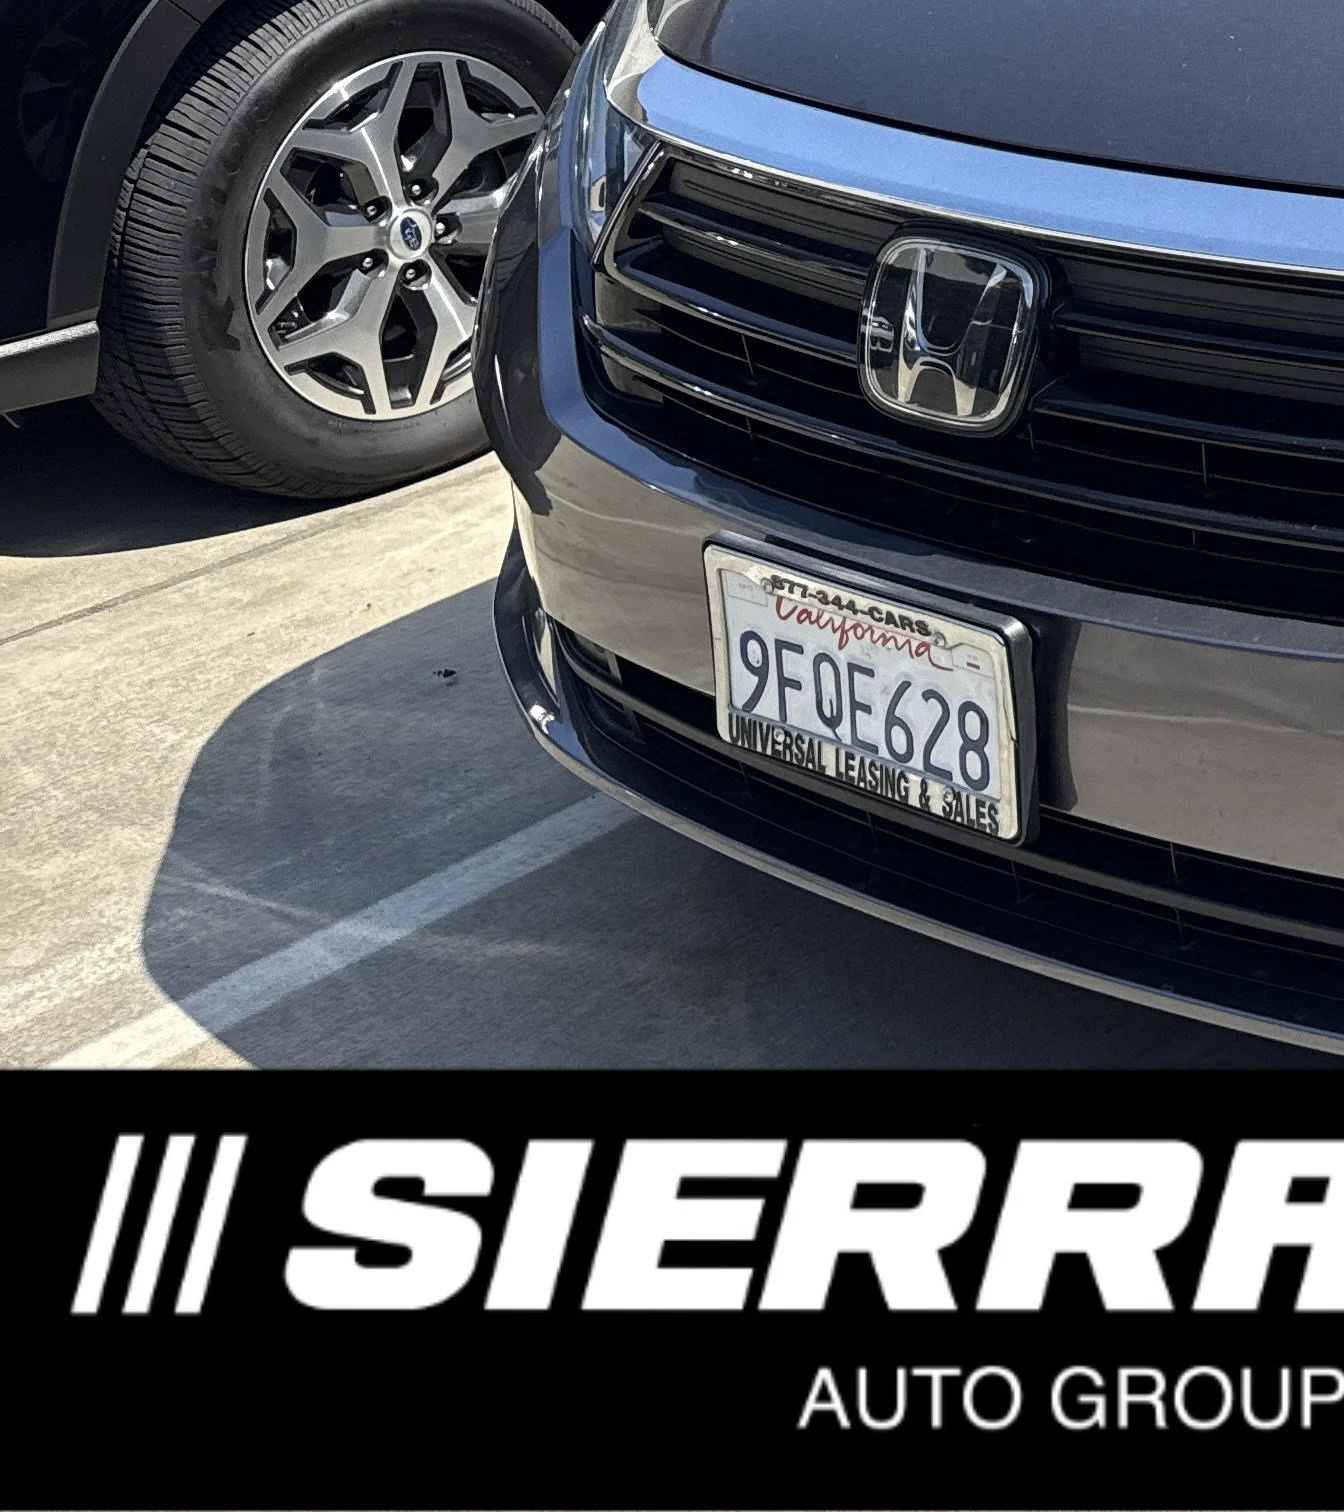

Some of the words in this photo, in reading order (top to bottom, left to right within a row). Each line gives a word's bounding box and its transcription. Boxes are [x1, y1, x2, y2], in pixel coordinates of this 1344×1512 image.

[771, 574, 932, 636] 877-344-CARS
[775, 595, 954, 672] California
[739, 630, 990, 792] 9FQE628
[728, 712, 827, 773] UNIVERSAL
[835, 746, 909, 806] LEASING
[918, 778, 931, 812] &
[941, 786, 1000, 836] SALES
